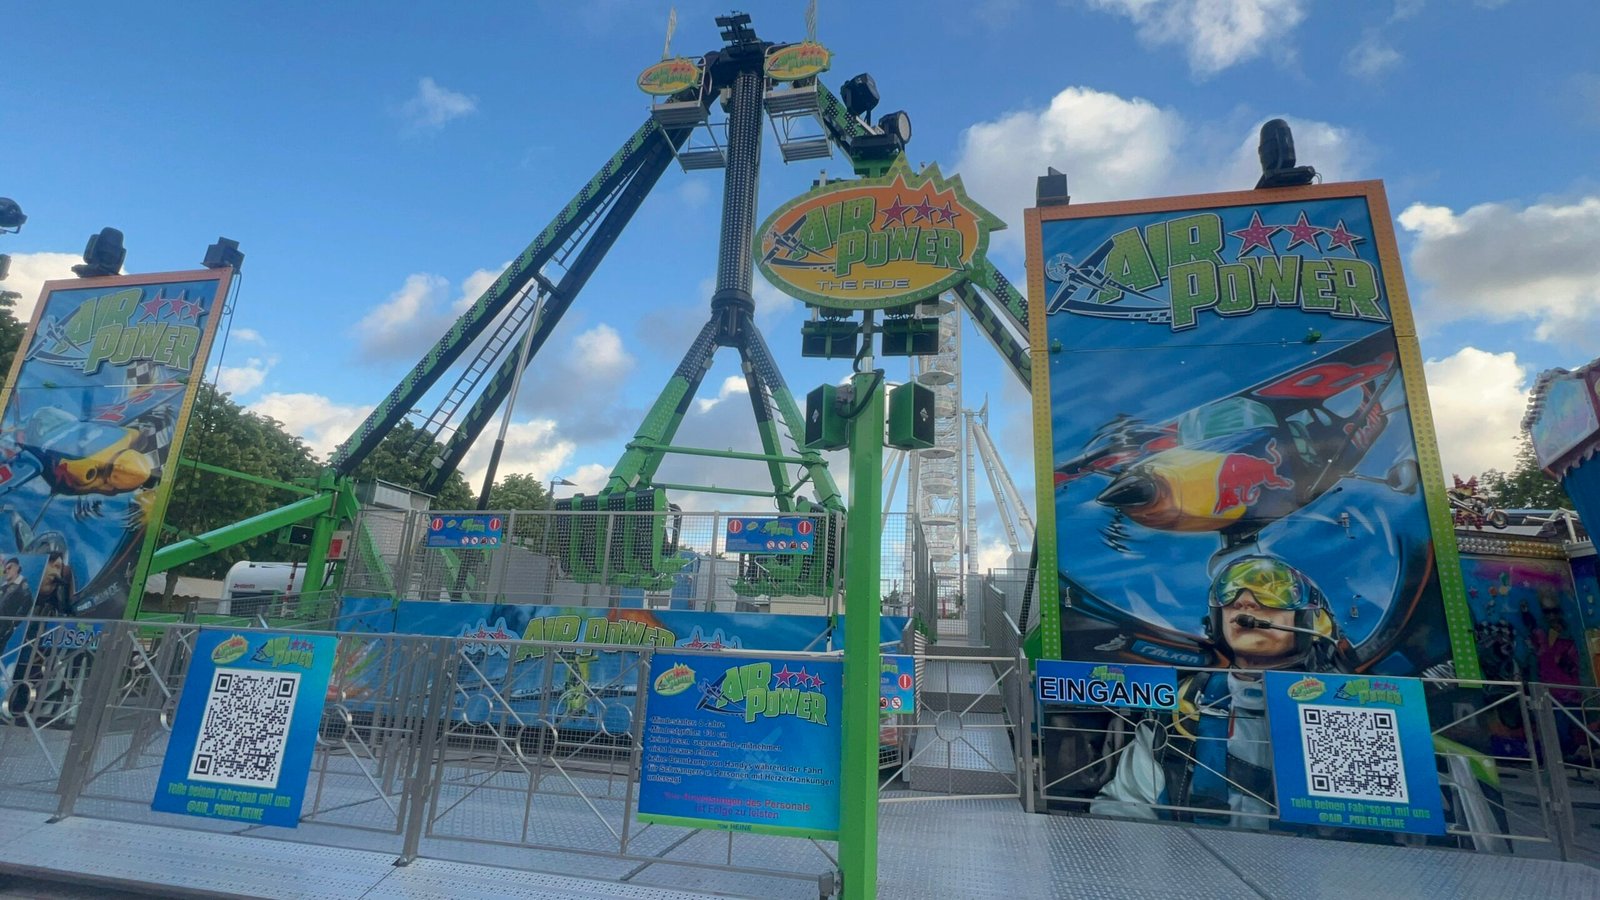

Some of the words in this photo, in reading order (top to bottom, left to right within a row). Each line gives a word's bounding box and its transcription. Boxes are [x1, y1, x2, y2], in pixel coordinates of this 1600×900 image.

[791, 196, 879, 261] AIR
[835, 226, 966, 278] POWER
[1097, 213, 1223, 304] AIR
[816, 279, 857, 290] THE
[862, 279, 910, 289] RIDE
[1168, 255, 1392, 332] POWER
[52, 288, 144, 354] AIR
[83, 322, 200, 375] POWER
[516, 615, 581, 662] AIR
[716, 662, 771, 708] AIR
[1038, 676, 1177, 708] EINGANG
[745, 687, 827, 726] POWER
[764, 773, 835, 786] Herzerkrankungen
[803, 766, 823, 775] Fahrt
[735, 808, 746, 816] zu
[748, 807, 779, 819] leisten
[745, 797, 763, 808] des
[764, 799, 811, 813] Personals
[1412, 808, 1431, 818] uns
[730, 823, 752, 831] HEINE
